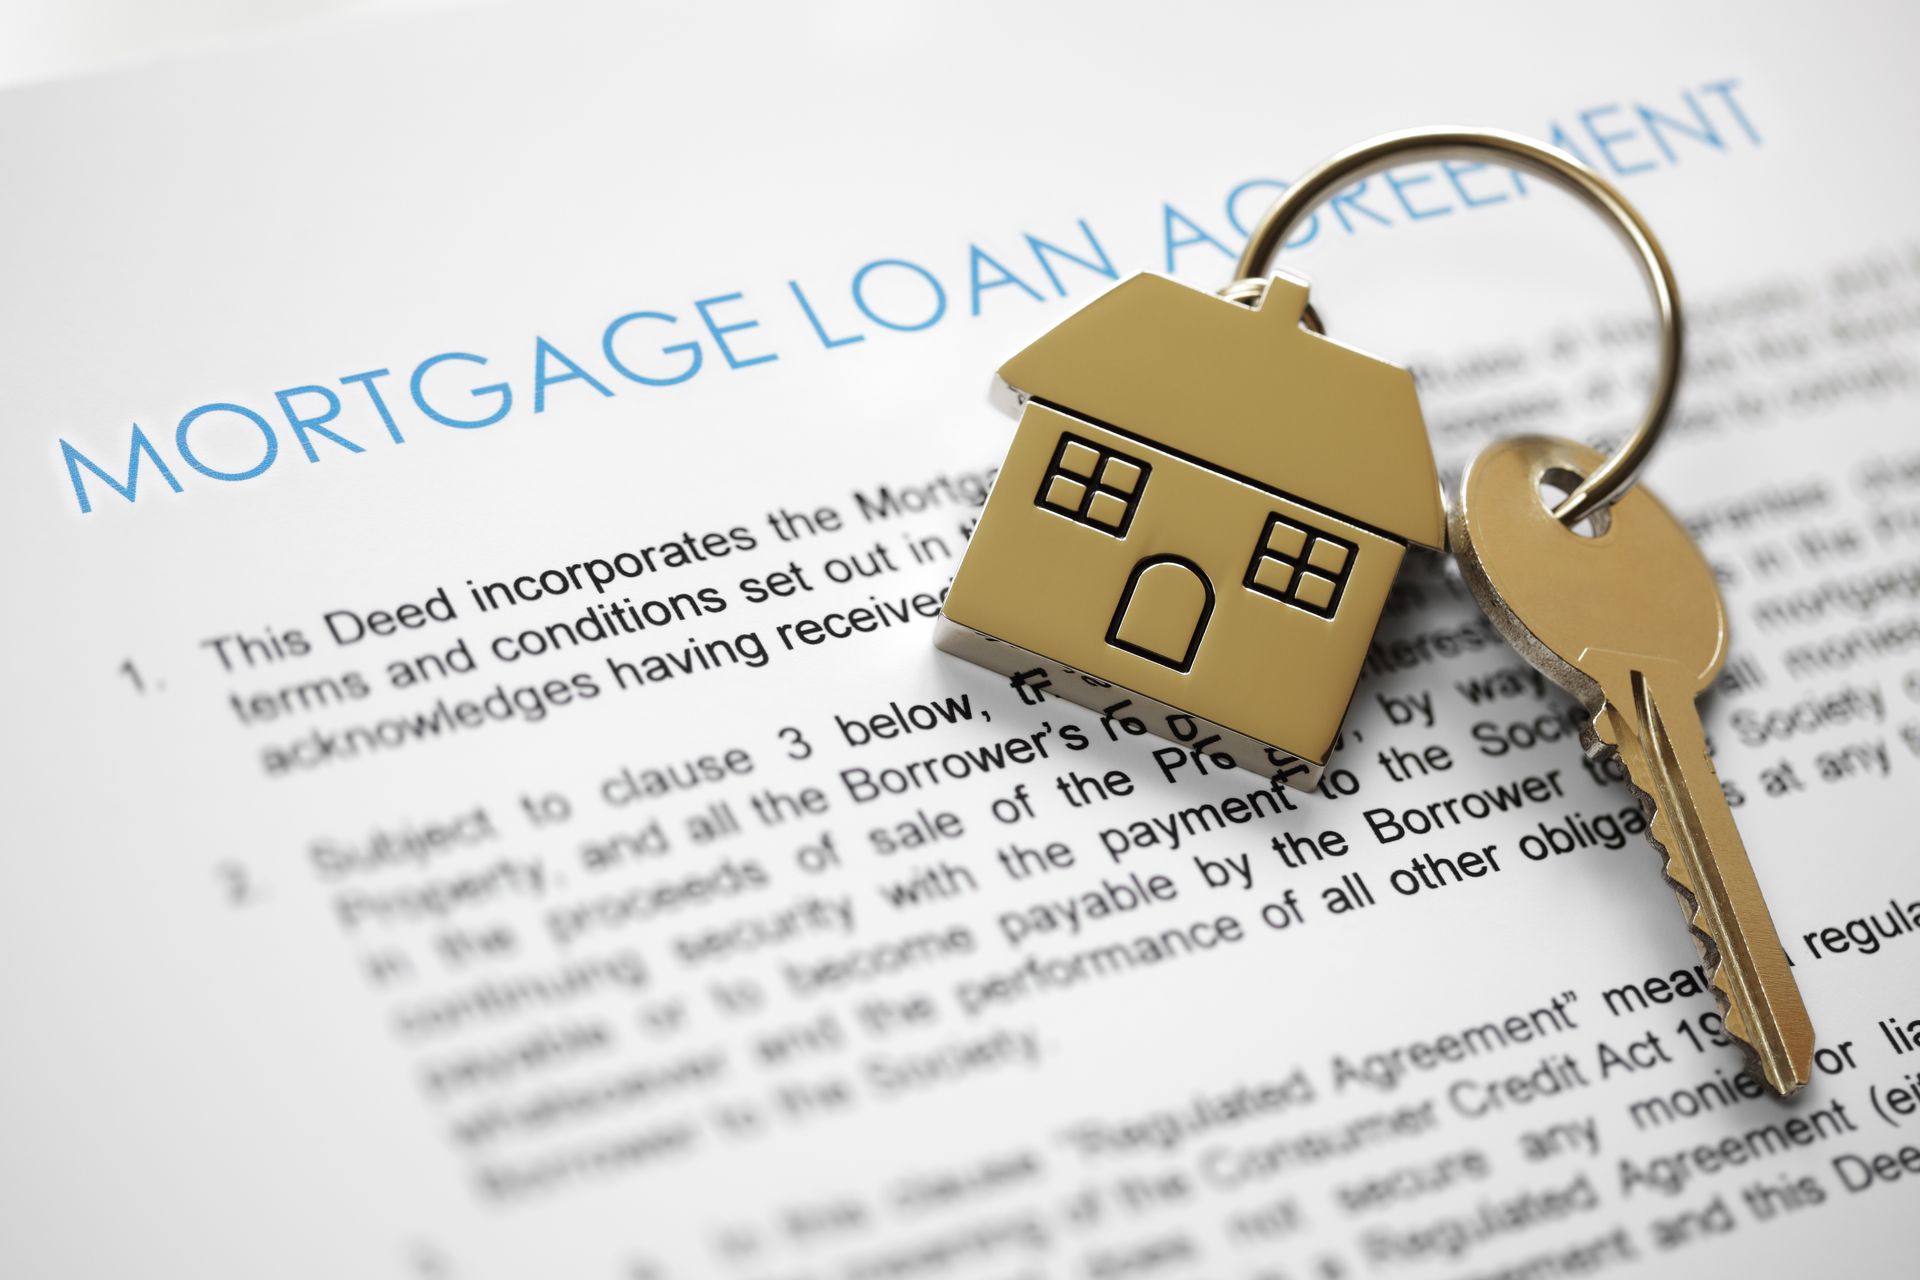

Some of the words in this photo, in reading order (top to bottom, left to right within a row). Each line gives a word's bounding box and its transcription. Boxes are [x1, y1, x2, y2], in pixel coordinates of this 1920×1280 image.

[59, 290, 779, 514] MORTGAGE
[788, 217, 1121, 350] LOAN
[201, 626, 312, 674] This
[322, 587, 458, 647] Deed
[466, 526, 758, 612] incorporates
[767, 506, 843, 543] the
[228, 670, 371, 727] terms
[386, 637, 477, 689] and
[491, 585, 728, 663] conditions
[739, 562, 814, 604] set
[824, 543, 899, 585] out
[905, 531, 952, 565] in
[261, 671, 601, 777] acknowledges
[607, 630, 770, 691] having
[519, 792, 573, 829] to
[600, 747, 754, 806] clause
[778, 726, 814, 762] 3
[835, 692, 992, 748] below,
[578, 818, 671, 873] and
[685, 800, 742, 845] all
[750, 788, 831, 827] the
[795, 830, 843, 875] of
[868, 809, 966, 857] sale
[991, 783, 1037, 825] of
[1056, 769, 1135, 809] the
[1376, 690, 1435, 727] by
[880, 860, 979, 910] with
[997, 840, 1076, 881] the
[1098, 780, 1299, 864] payment
[1317, 768, 1360, 801] to
[1376, 743, 1455, 784] the
[997, 872, 1179, 945] payable
[1193, 851, 1255, 890] by
[1270, 828, 1350, 870] the
[1363, 768, 1566, 845] Borrower
[1261, 888, 1305, 930] of
[1320, 871, 1376, 916] all
[1390, 843, 1499, 897] other
[1758, 756, 1807, 798] at
[1813, 737, 1891, 783] any
[1446, 1051, 1591, 1120] Credit
[1596, 1030, 1675, 1080] Act
[1676, 1010, 1731, 1053] 19
[1517, 1114, 1601, 1164] any
[1628, 1066, 1766, 1131] monie
[1814, 1040, 1857, 1076] or
[1617, 1098, 1858, 1199] Agreement
[1650, 1194, 1738, 1252] and
[1741, 1172, 1828, 1222] this
